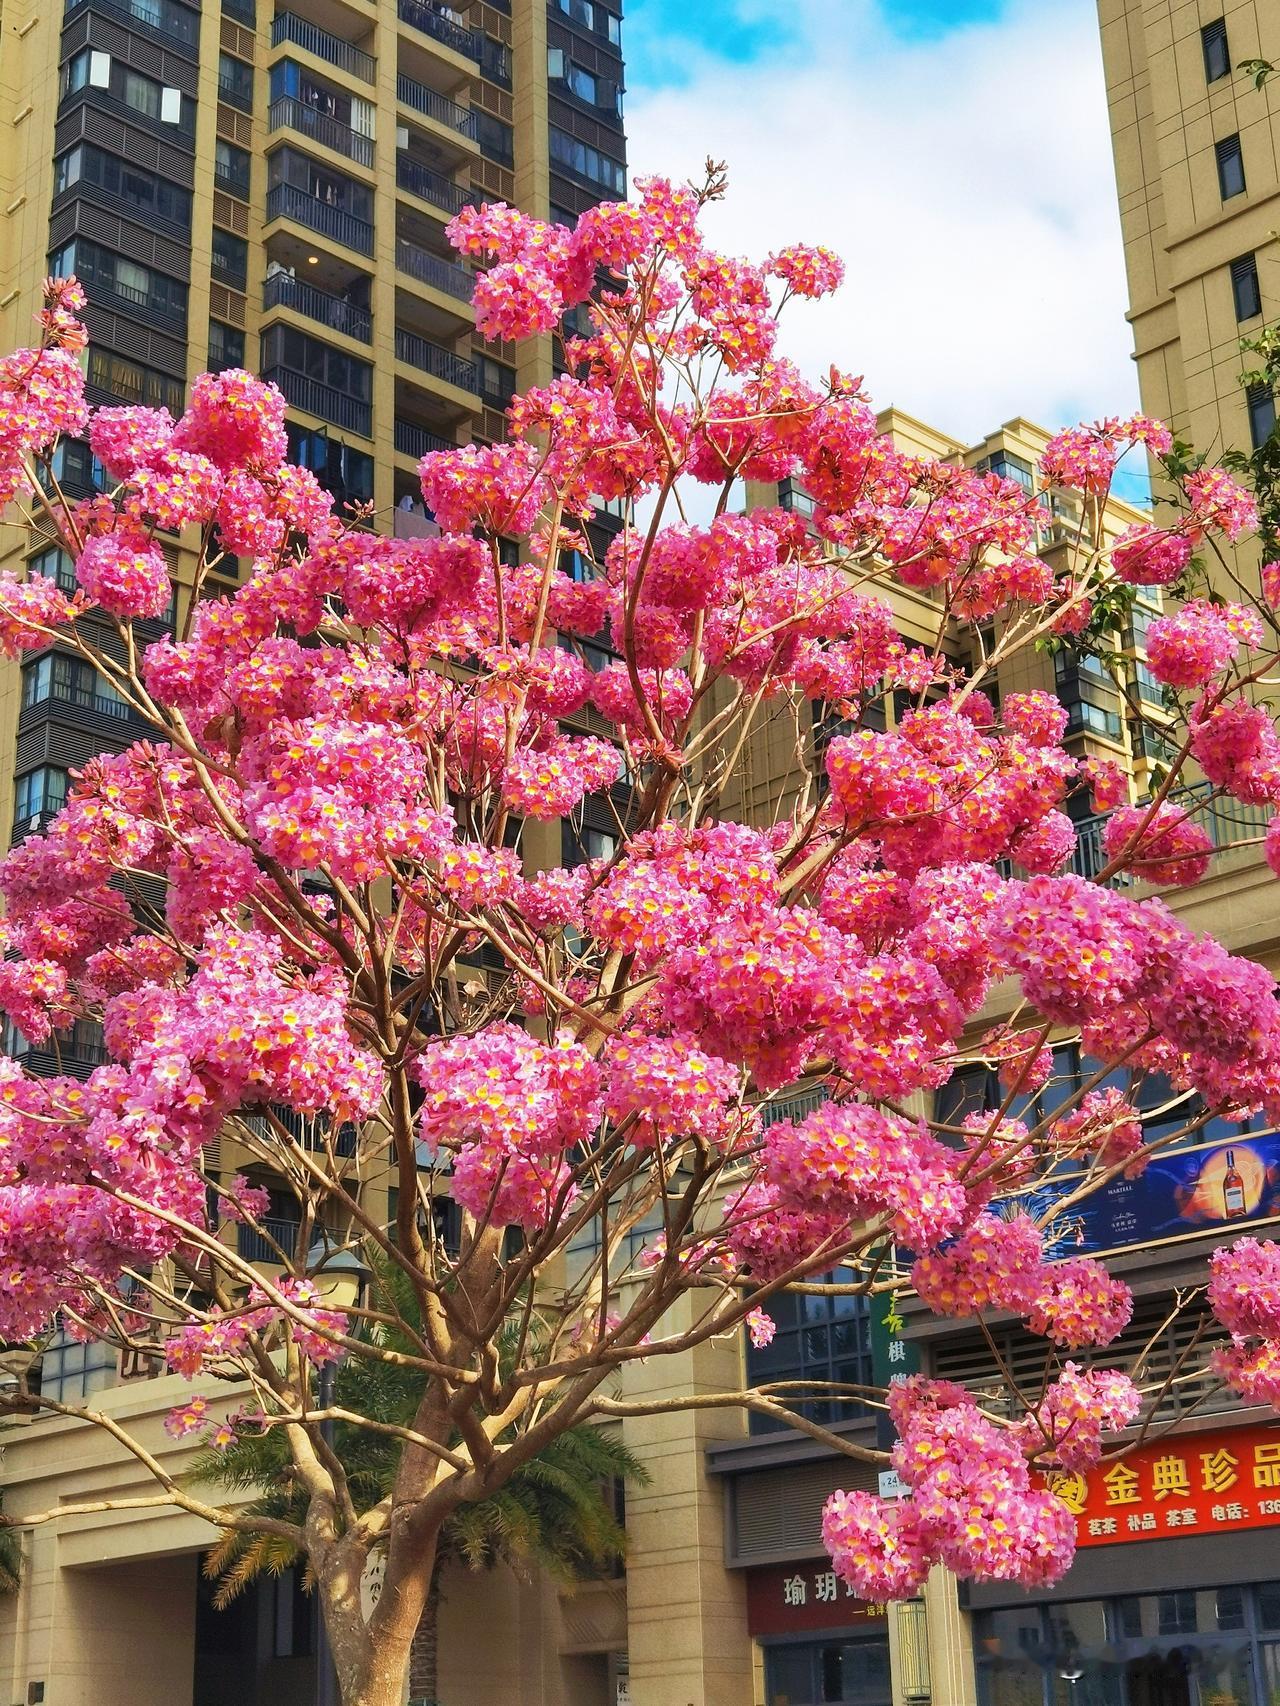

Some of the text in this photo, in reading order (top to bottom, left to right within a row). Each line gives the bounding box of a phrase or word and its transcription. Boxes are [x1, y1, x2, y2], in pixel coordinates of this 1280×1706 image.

[1103, 1443, 1280, 1506] 金典珍品
[1088, 1517, 1117, 1537] 茗茶
[1127, 1512, 1157, 1532] 补品
[1166, 1508, 1198, 1527] 茶室
